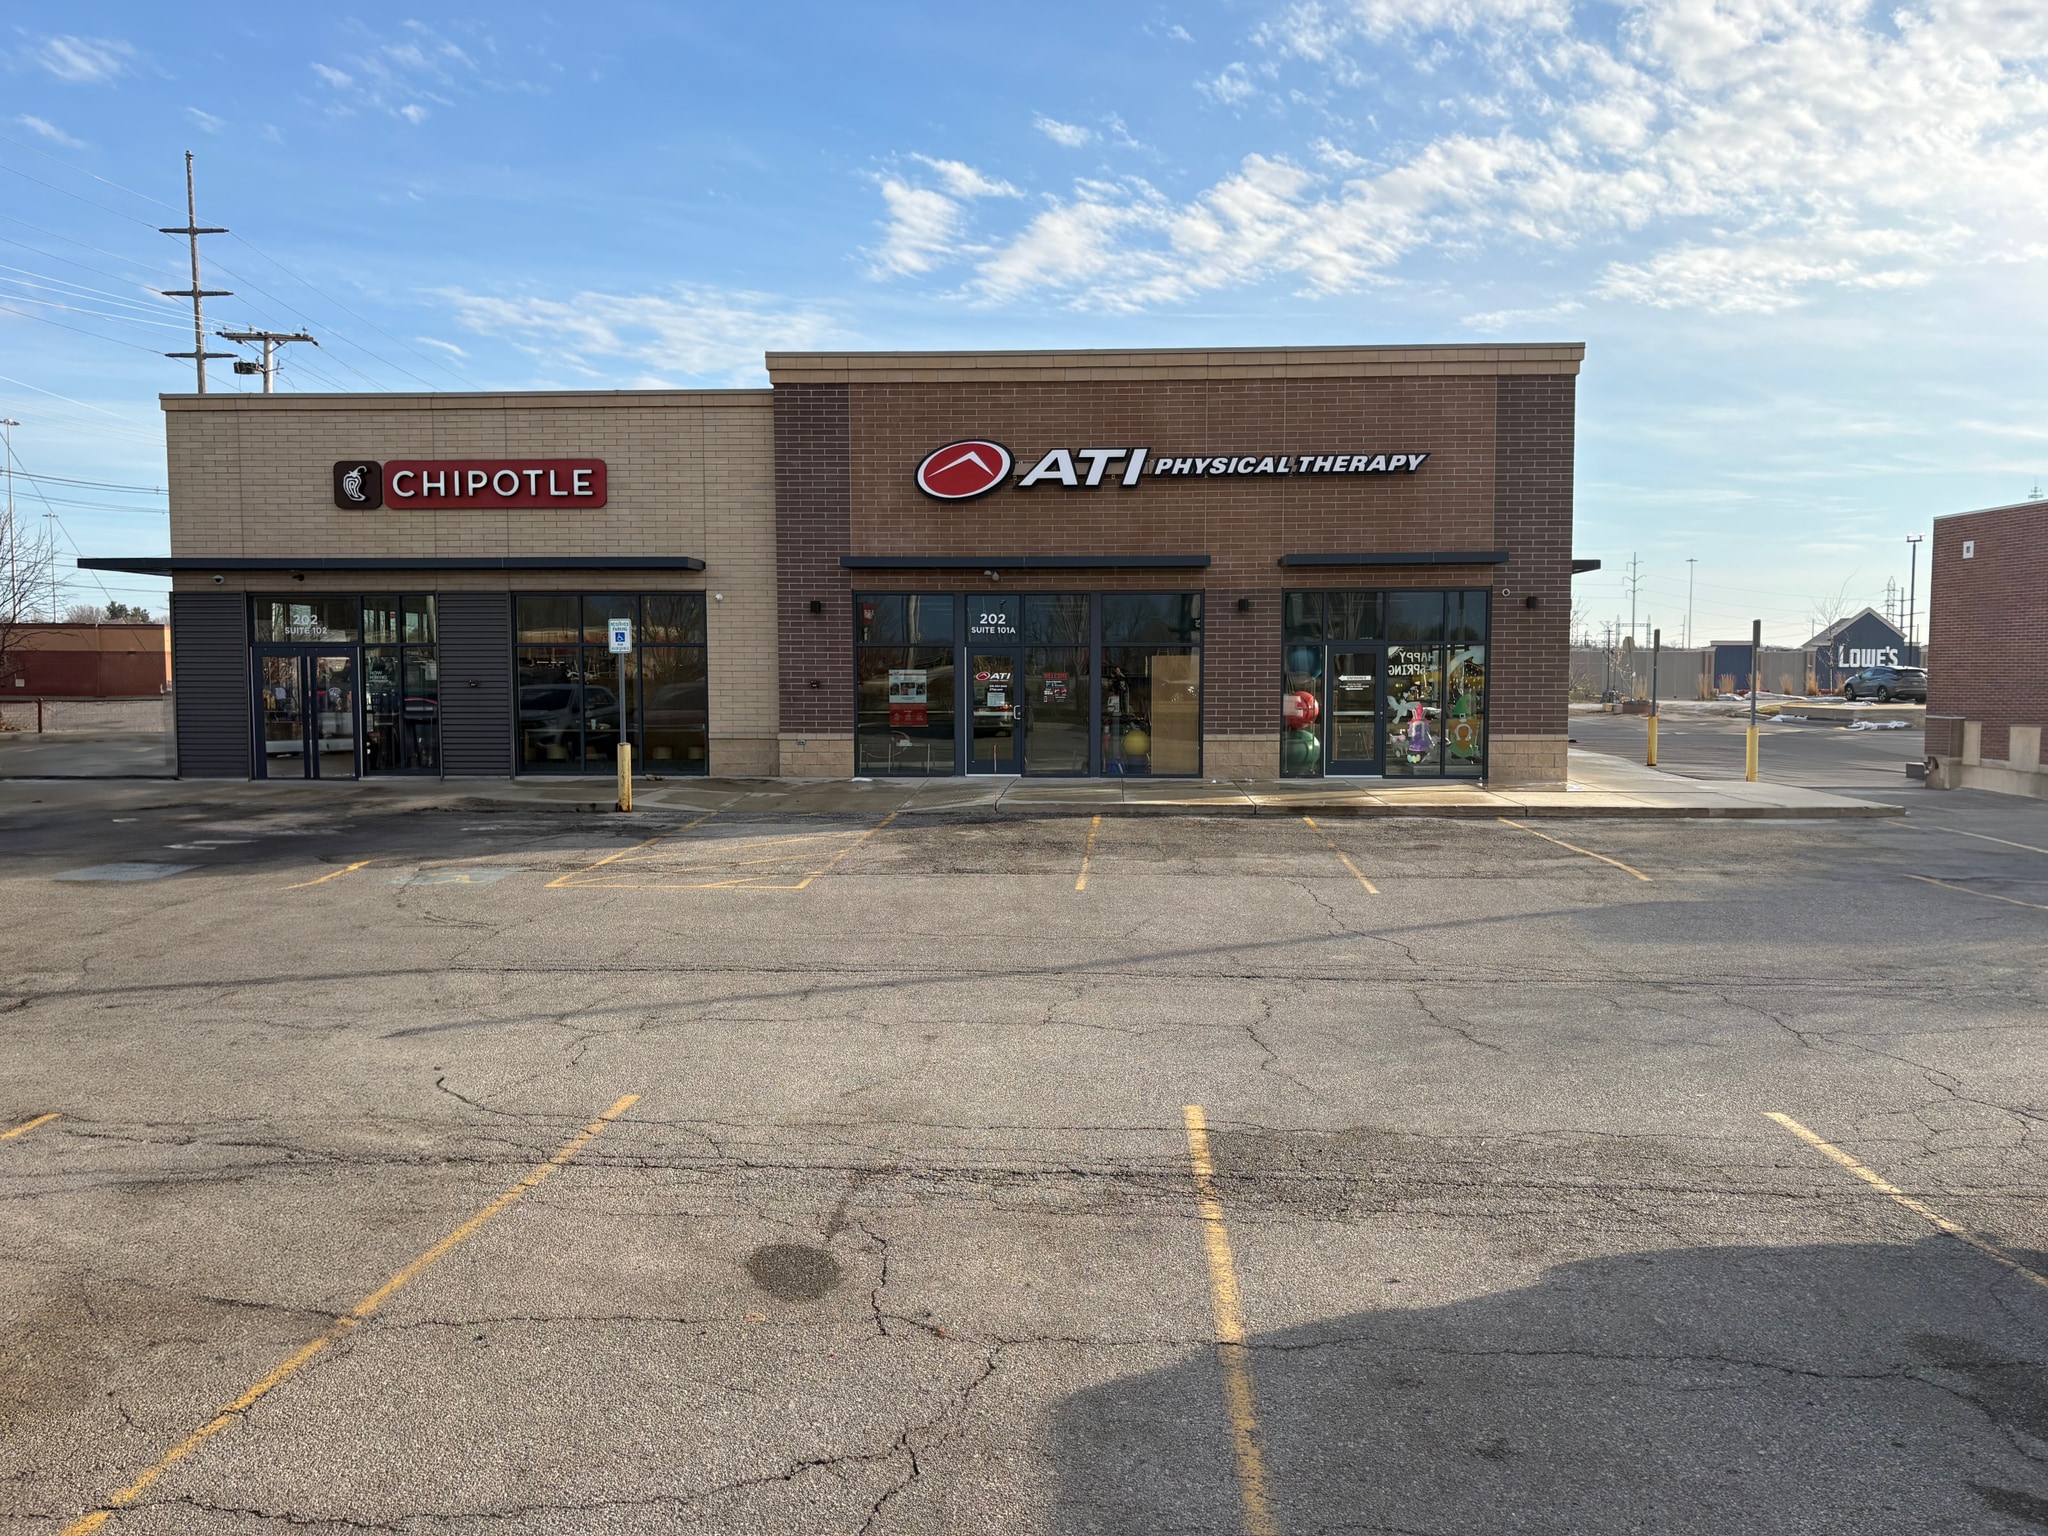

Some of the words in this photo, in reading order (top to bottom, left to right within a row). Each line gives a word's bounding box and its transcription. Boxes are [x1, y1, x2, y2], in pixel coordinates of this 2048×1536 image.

[1018, 447, 1150, 487] ATI
[1154, 455, 1291, 475] PHYSICAL
[1298, 453, 1426, 473] THERAPY
[392, 469, 594, 497] CHIPOTLE
[293, 614, 318, 625] 202
[979, 613, 1006, 625] 202
[971, 626, 996, 634] SUITE
[997, 626, 1016, 634] 101A
[1838, 646, 1898, 667] LOWE'S
